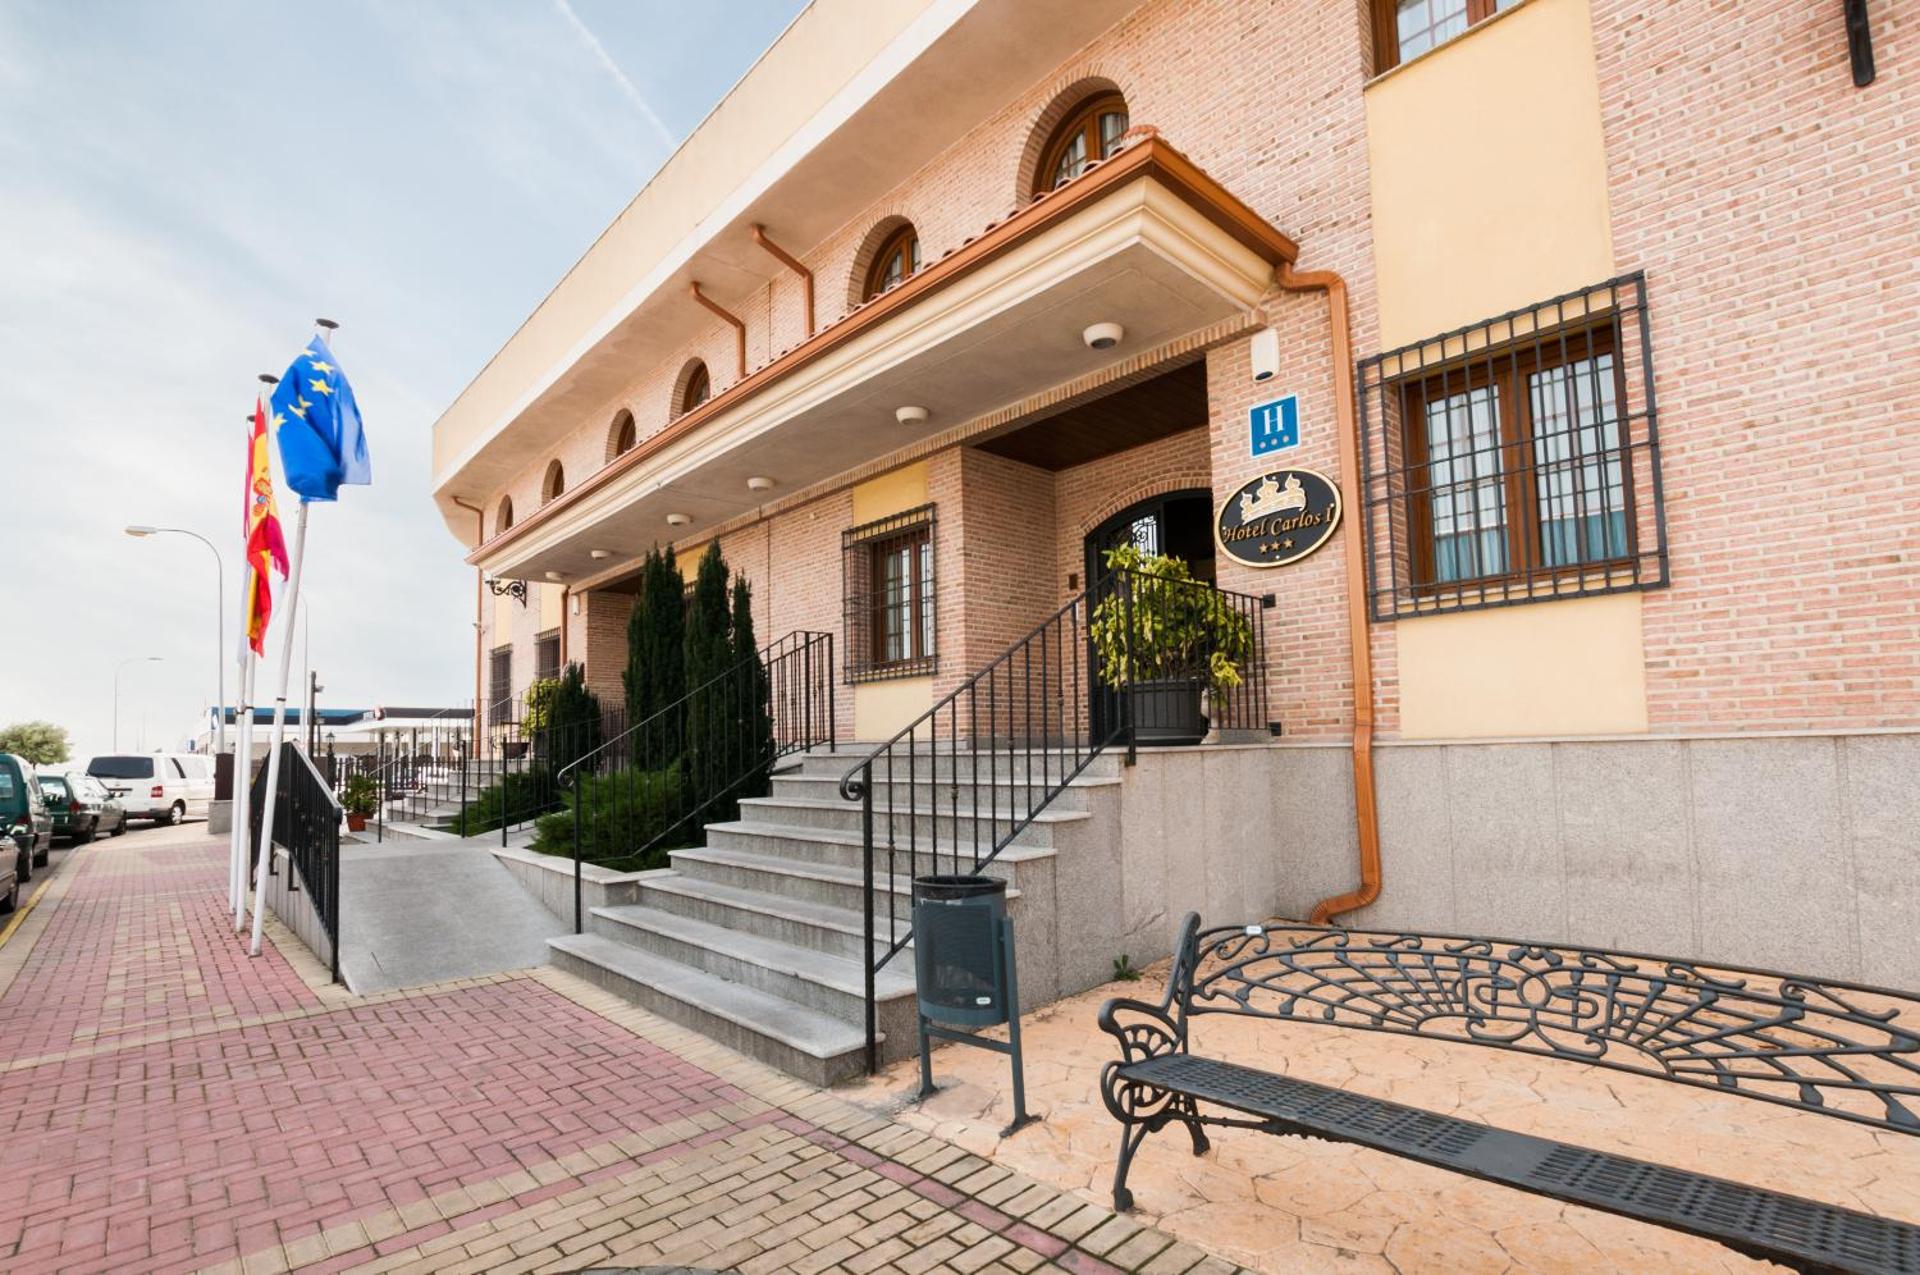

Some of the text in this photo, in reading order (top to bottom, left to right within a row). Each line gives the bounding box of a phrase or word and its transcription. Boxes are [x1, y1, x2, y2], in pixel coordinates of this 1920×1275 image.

[1263, 405, 1284, 435] H
[1224, 507, 1333, 542] Hotel Carlos I
